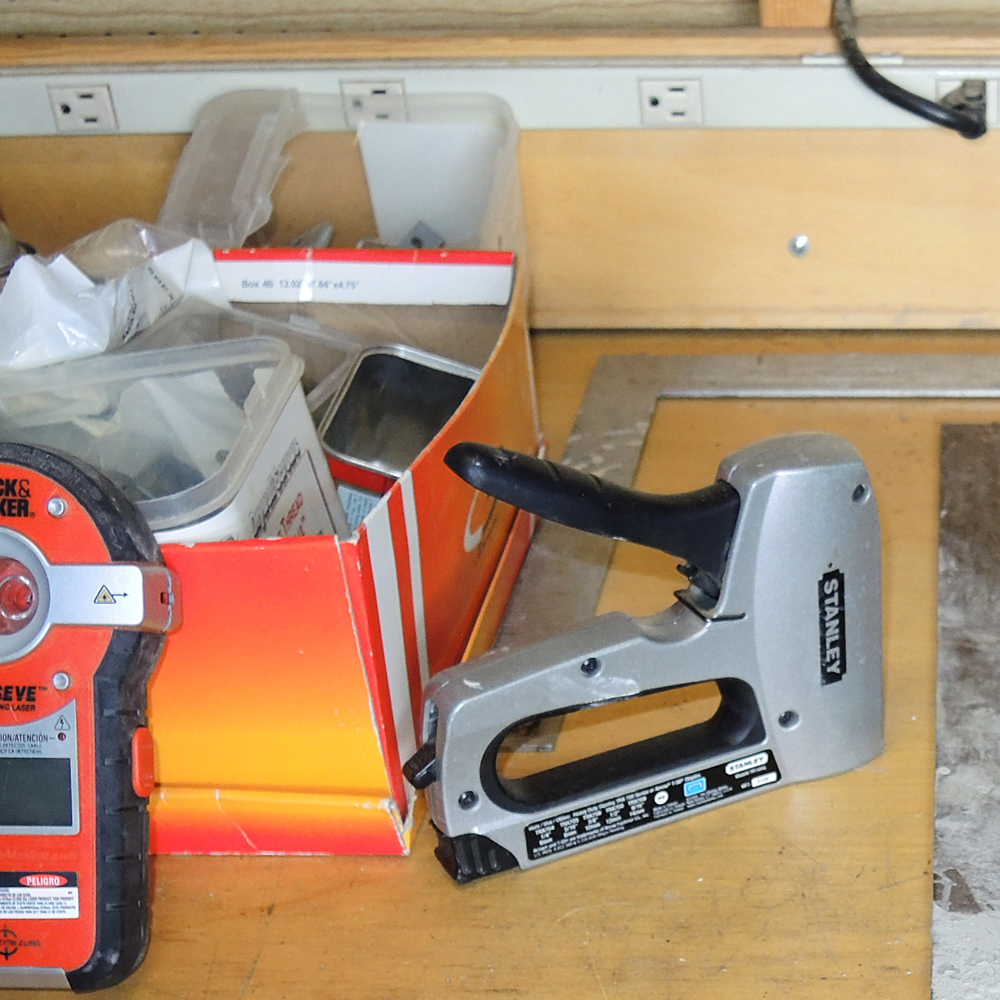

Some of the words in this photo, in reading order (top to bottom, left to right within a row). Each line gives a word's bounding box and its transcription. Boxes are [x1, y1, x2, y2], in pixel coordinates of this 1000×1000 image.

[823, 578, 841, 674] STANLEY
[730, 756, 765, 771] STANLEY
[26, 875, 60, 887] PELIGRO
